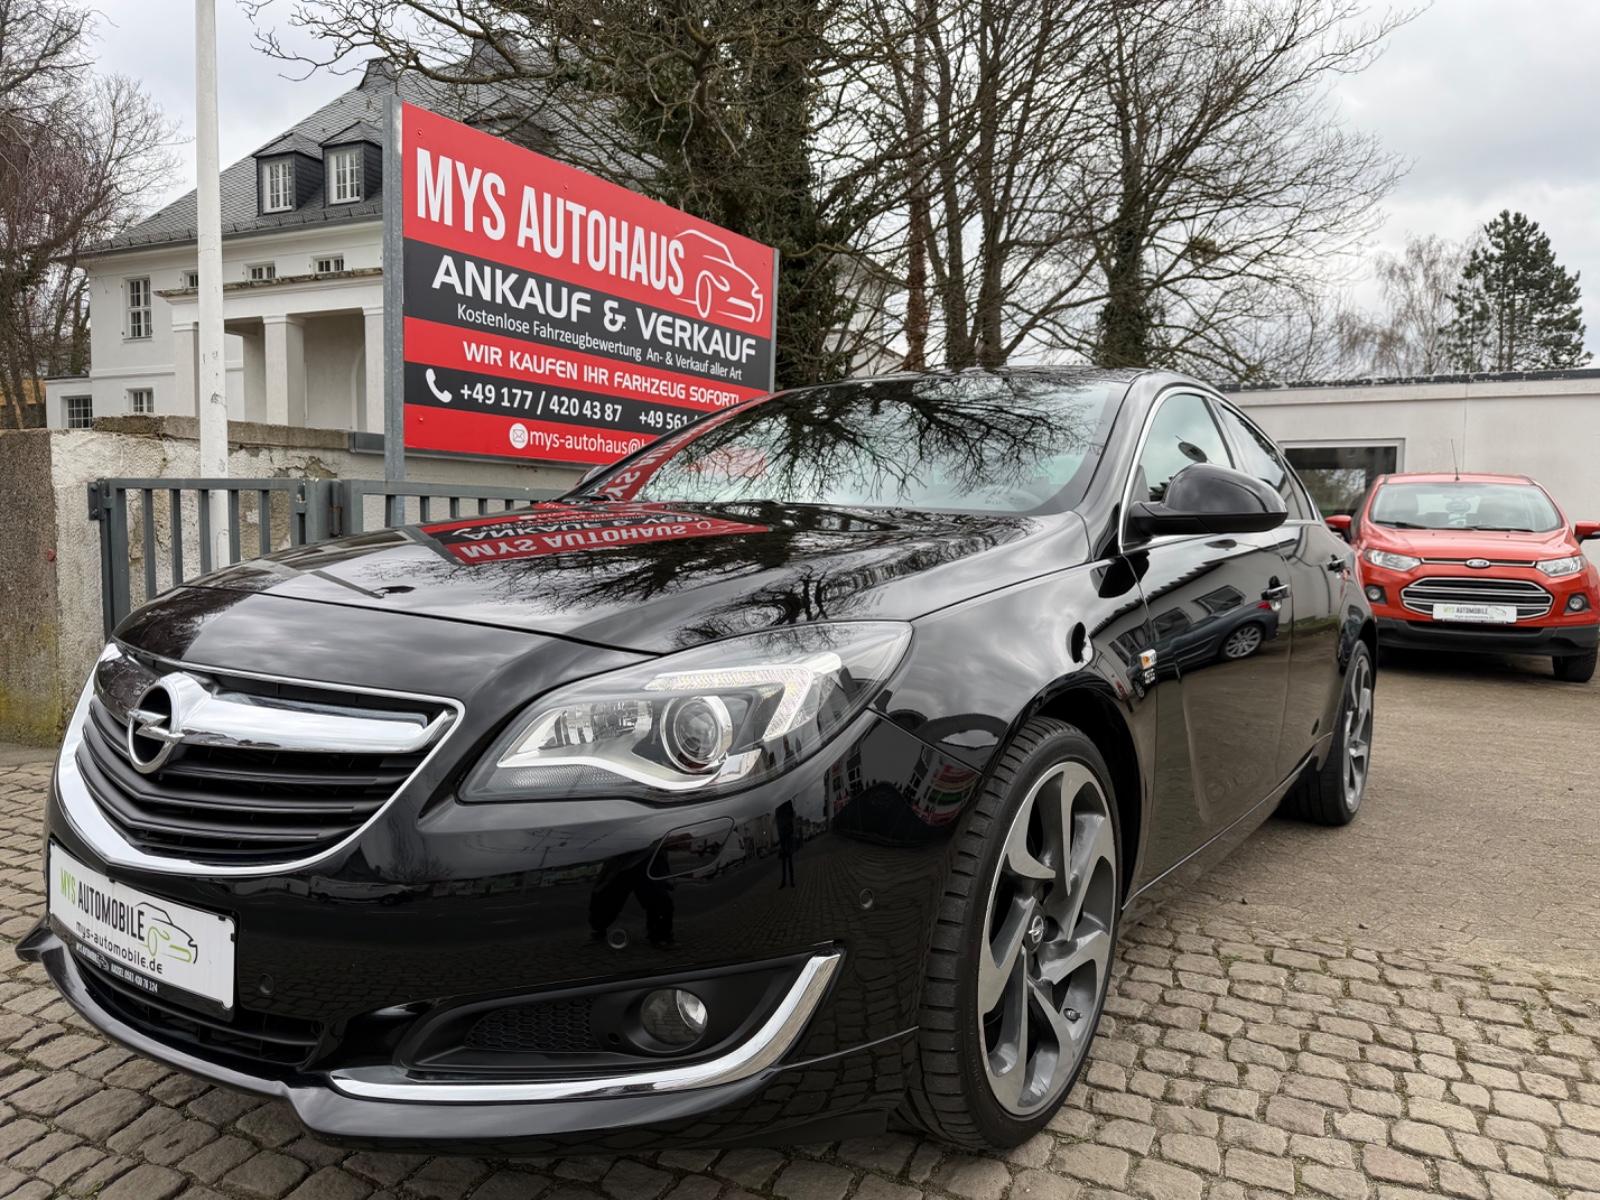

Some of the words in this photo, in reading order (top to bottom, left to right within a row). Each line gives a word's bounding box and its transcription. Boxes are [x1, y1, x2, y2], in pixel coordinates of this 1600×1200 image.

[417, 147, 506, 241] MYS
[517, 184, 685, 296] AUTOHAUS
[432, 255, 591, 323] ANKAUF
[603, 300, 626, 332] &
[636, 307, 756, 363] VERKAUF
[457, 303, 530, 334] Kostenlose
[533, 321, 642, 362] Fahrzeugbewertung
[646, 348, 663, 362] An-
[665, 352, 674, 366] &
[675, 354, 710, 370] Verkauf
[710, 362, 728, 377] aller
[729, 367, 743, 380] Art
[460, 383, 496, 405] +49
[501, 387, 533, 410] 177
[536, 391, 546, 415] /
[550, 395, 580, 417] 420
[582, 400, 601, 419] 43
[604, 404, 622, 422] 87
[639, 409, 663, 428] +49
[666, 413, 688, 430] 561
[463, 341, 502, 367] WIR
[509, 350, 578, 380] KAUFEN
[583, 365, 609, 385] IHR
[614, 371, 686, 401] FARHZEUG
[60, 869, 76, 906] MYS
[77, 881, 145, 942] AUTOMOBILE
[75, 921, 163, 975] mys-automobile.de
